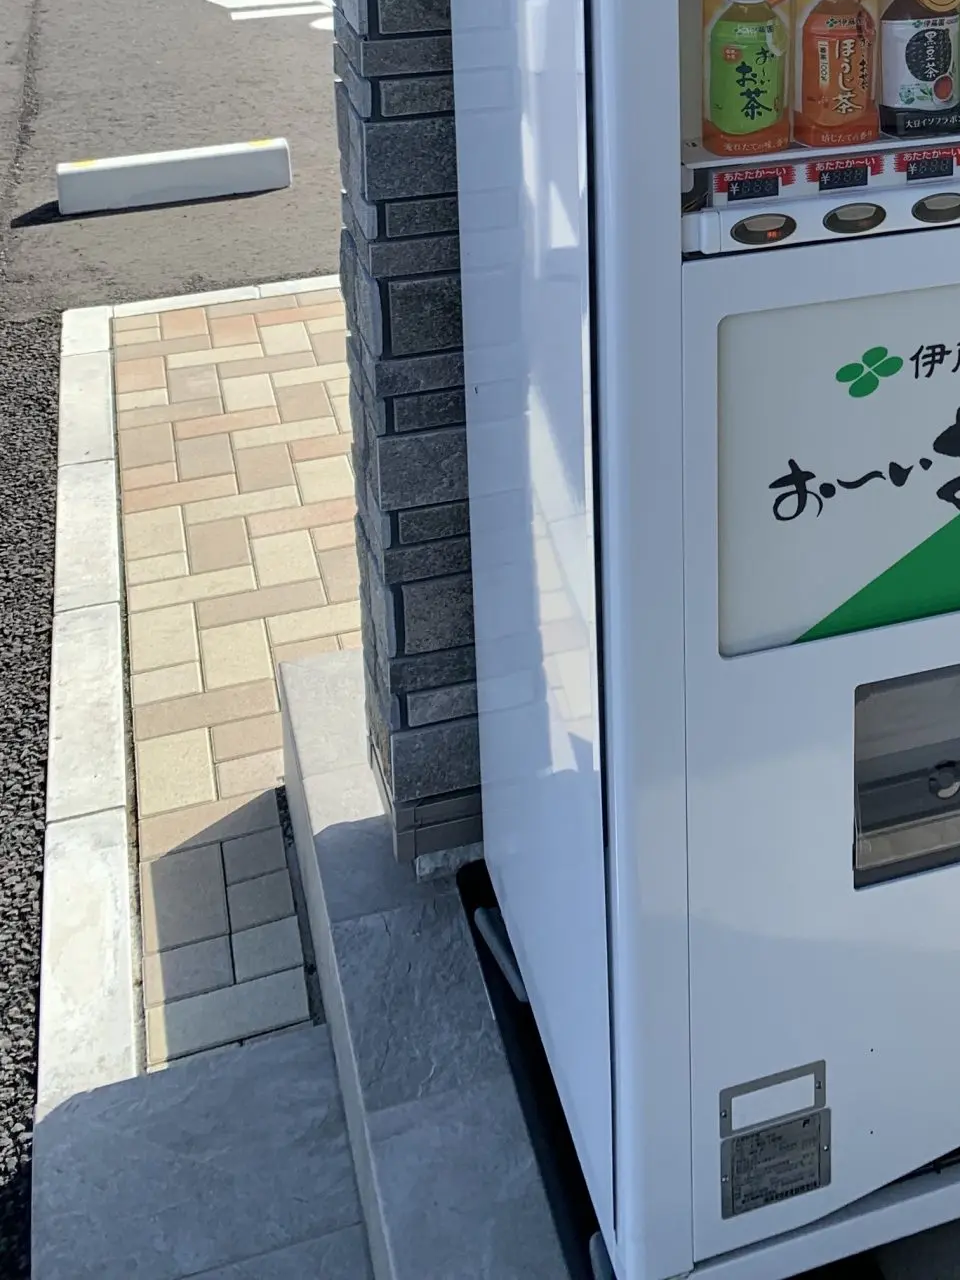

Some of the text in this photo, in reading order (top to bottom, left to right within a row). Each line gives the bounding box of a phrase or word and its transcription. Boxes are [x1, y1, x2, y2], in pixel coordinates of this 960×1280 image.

[735, 60, 773, 121] お茶
[832, 38, 864, 114] ほうじ茶
